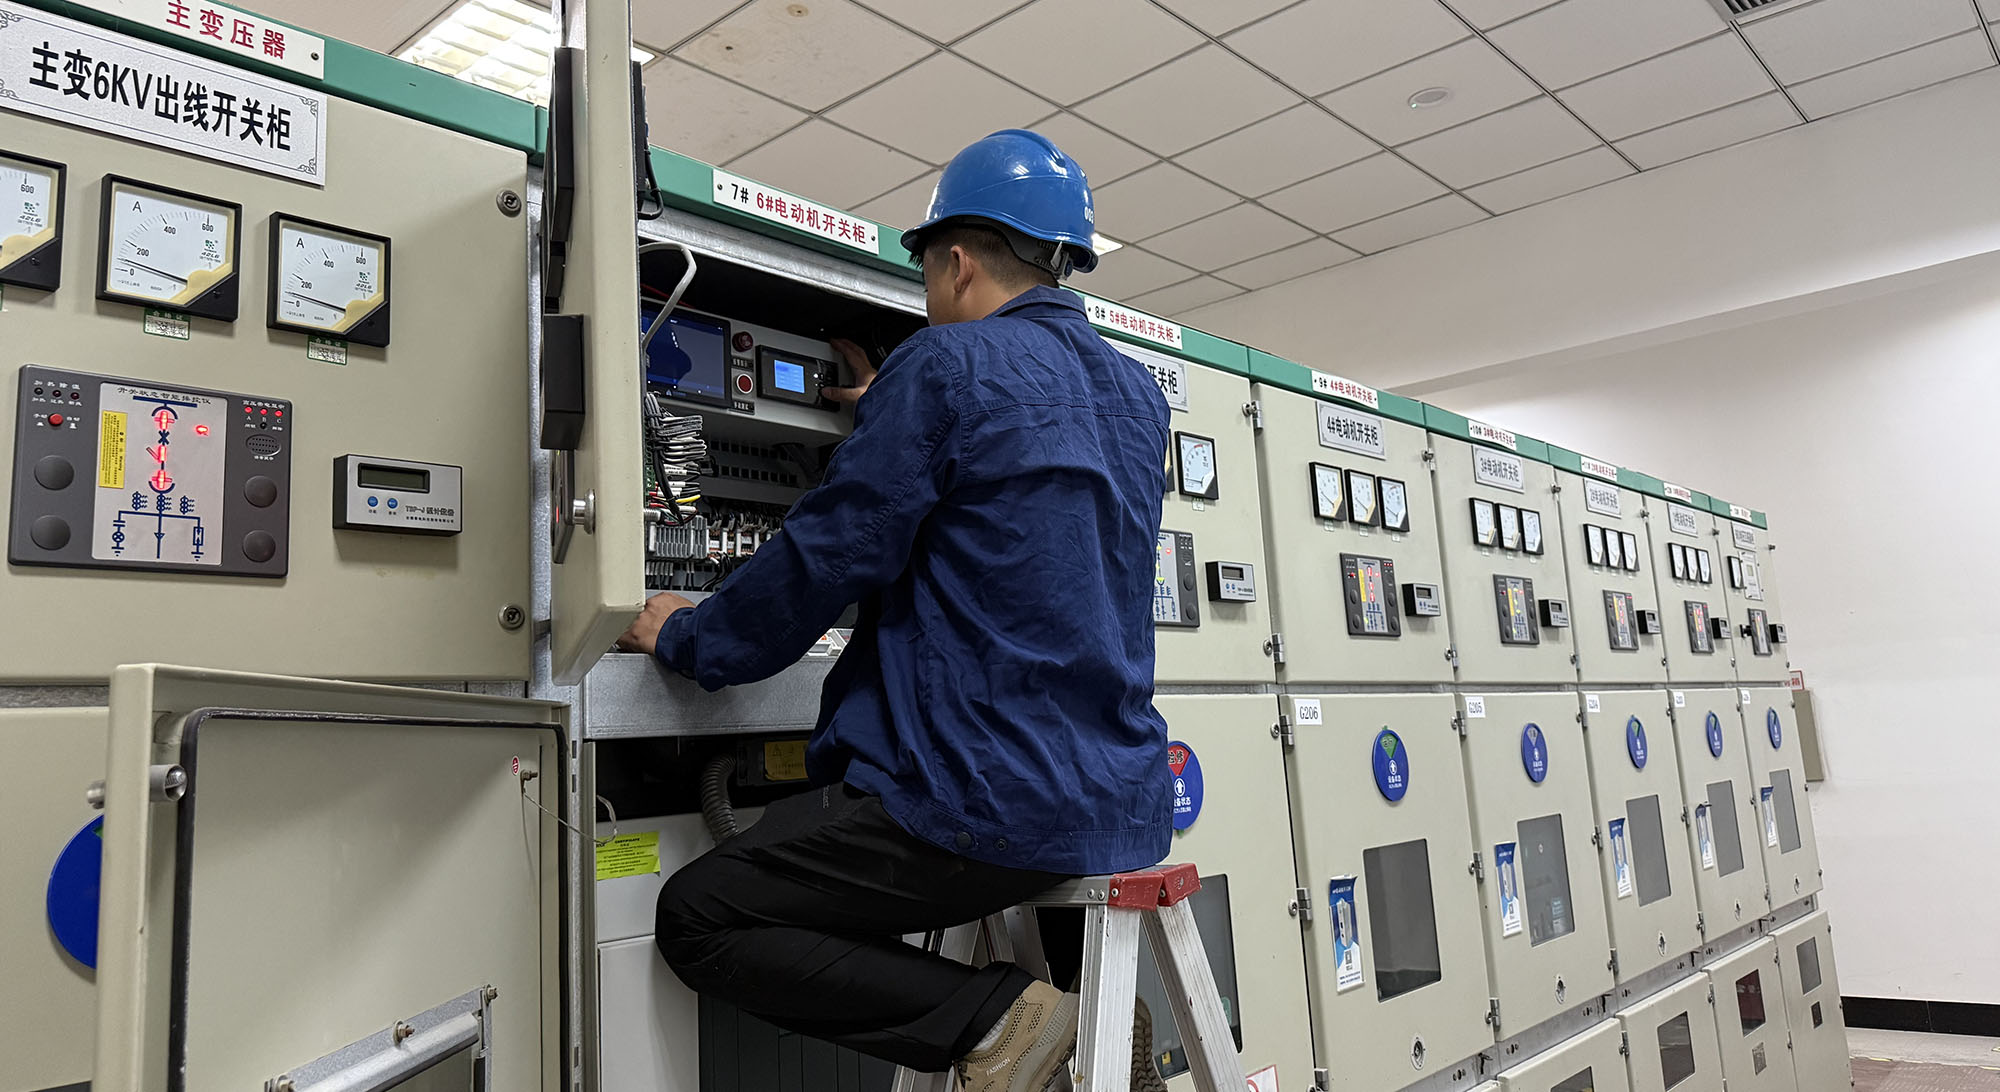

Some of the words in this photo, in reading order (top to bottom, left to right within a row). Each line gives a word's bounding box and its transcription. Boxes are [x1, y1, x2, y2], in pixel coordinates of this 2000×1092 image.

[166, 0, 286, 59] 主变压器
[29, 41, 291, 152] 主变6KV出线开关柜
[20, 184, 35, 194] 600
[132, 201, 142, 213] A
[731, 183, 749, 204] 7#
[756, 192, 866, 244] 6#电动机开关柜
[164, 225, 177, 235] 400
[201, 223, 214, 233] 600
[296, 237, 305, 249] A
[136, 247, 150, 257] 200
[323, 259, 335, 268] 400
[355, 256, 367, 265] 600
[129, 268, 135, 276] 0
[301, 280, 313, 290] 200
[295, 300, 301, 308] 0
[1095, 306, 1106, 320] 8#
[1109, 310, 1175, 343] 5#电动机开关柜
[1327, 416, 1379, 446] 4#电动机开关柜
[1299, 706, 1319, 720] G206
